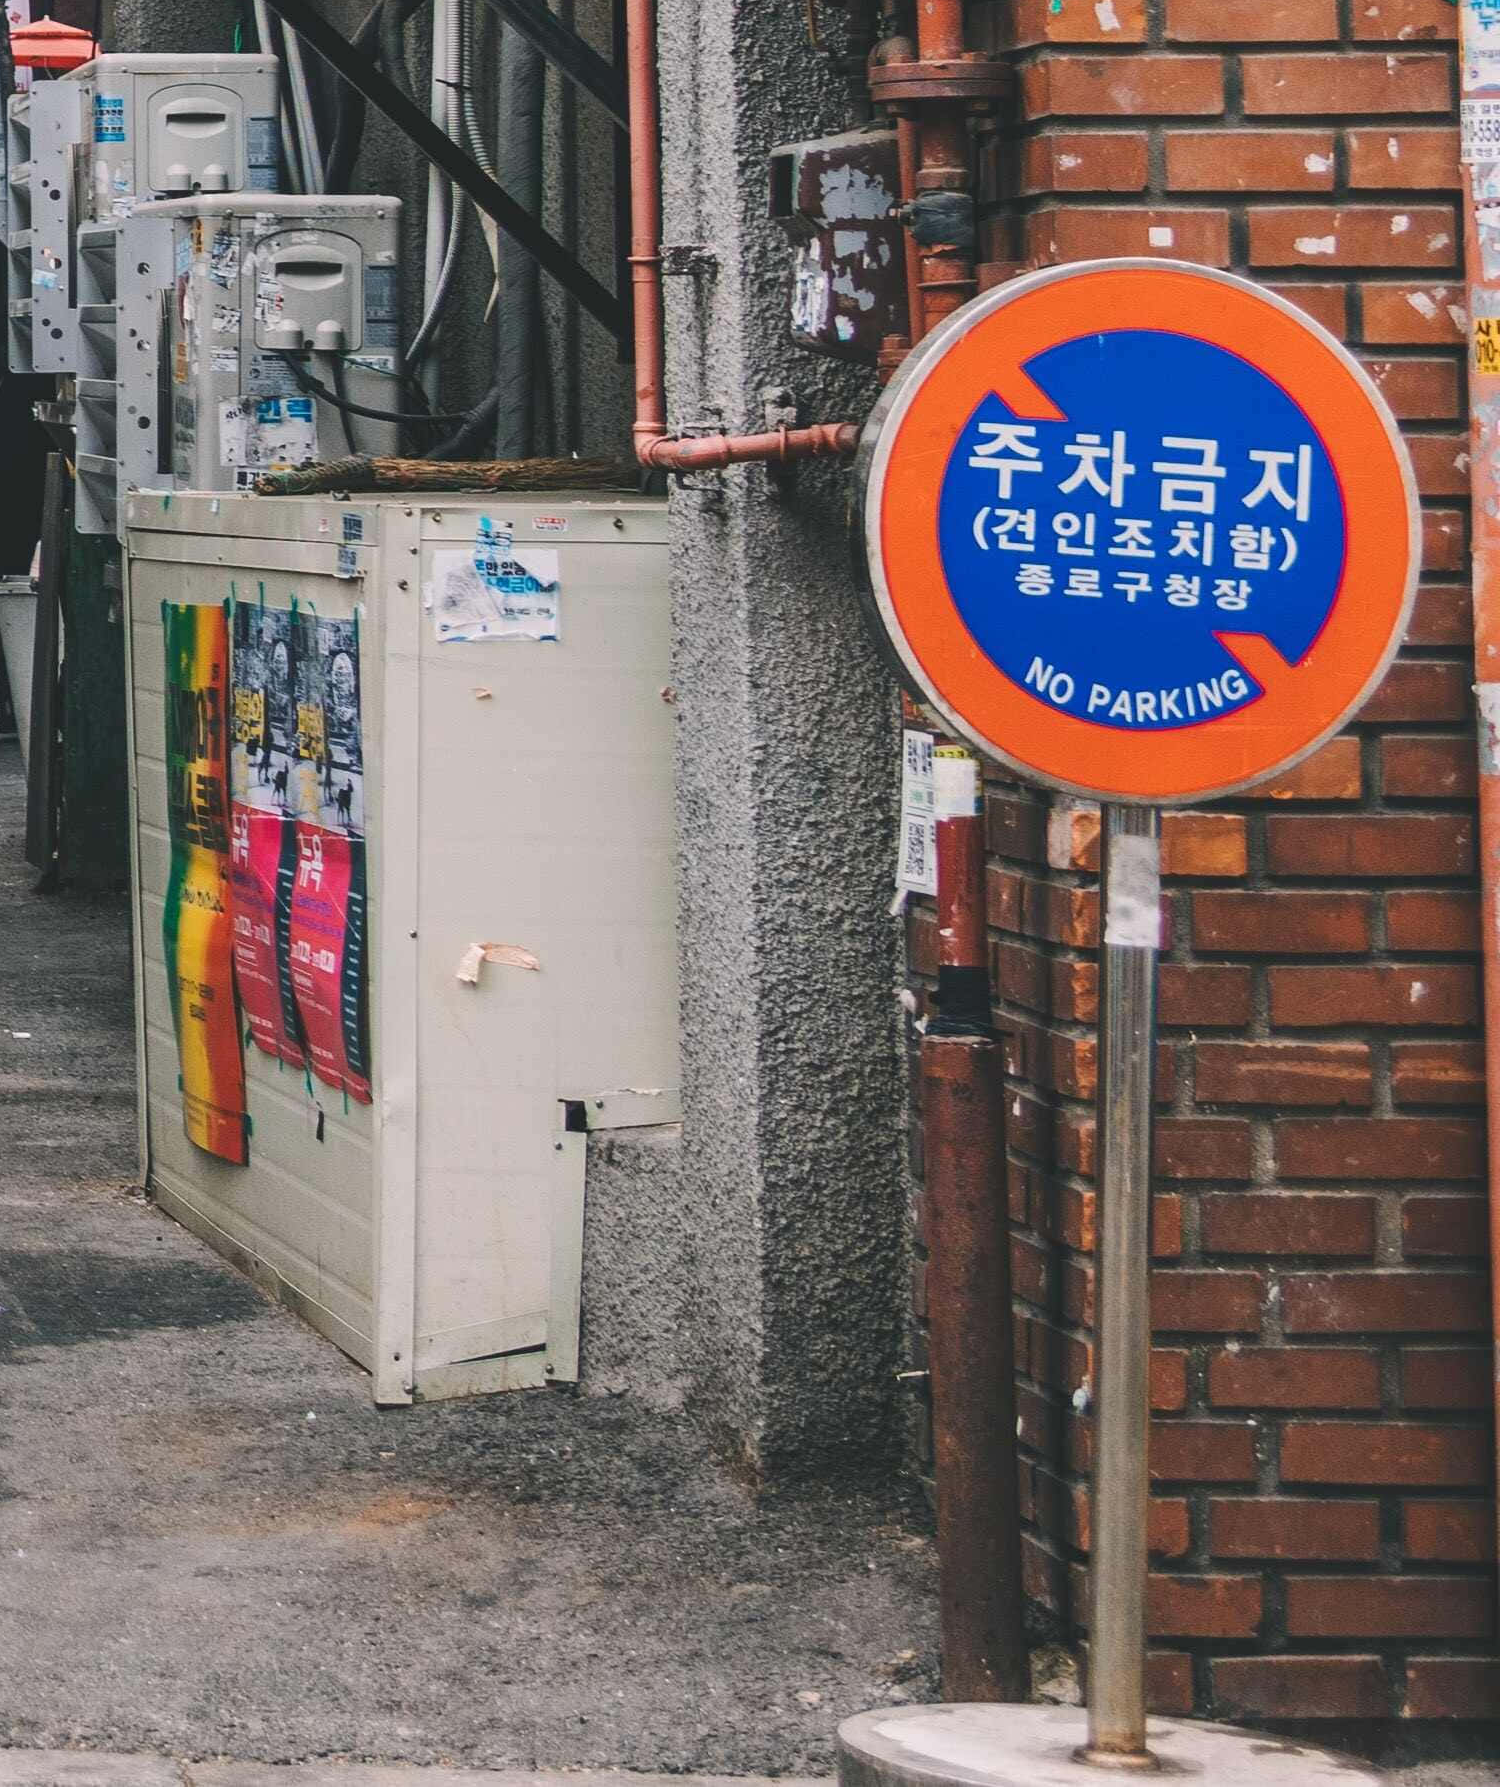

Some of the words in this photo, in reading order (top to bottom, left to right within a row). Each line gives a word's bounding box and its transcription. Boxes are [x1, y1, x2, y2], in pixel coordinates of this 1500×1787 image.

[968, 421, 1313, 523] 주차금지
[972, 506, 1298, 572] (견인조치함)
[1015, 563, 1253, 611] 종로구청장
[1024, 656, 1076, 705] NO
[1085, 668, 1250, 723] PARKING
